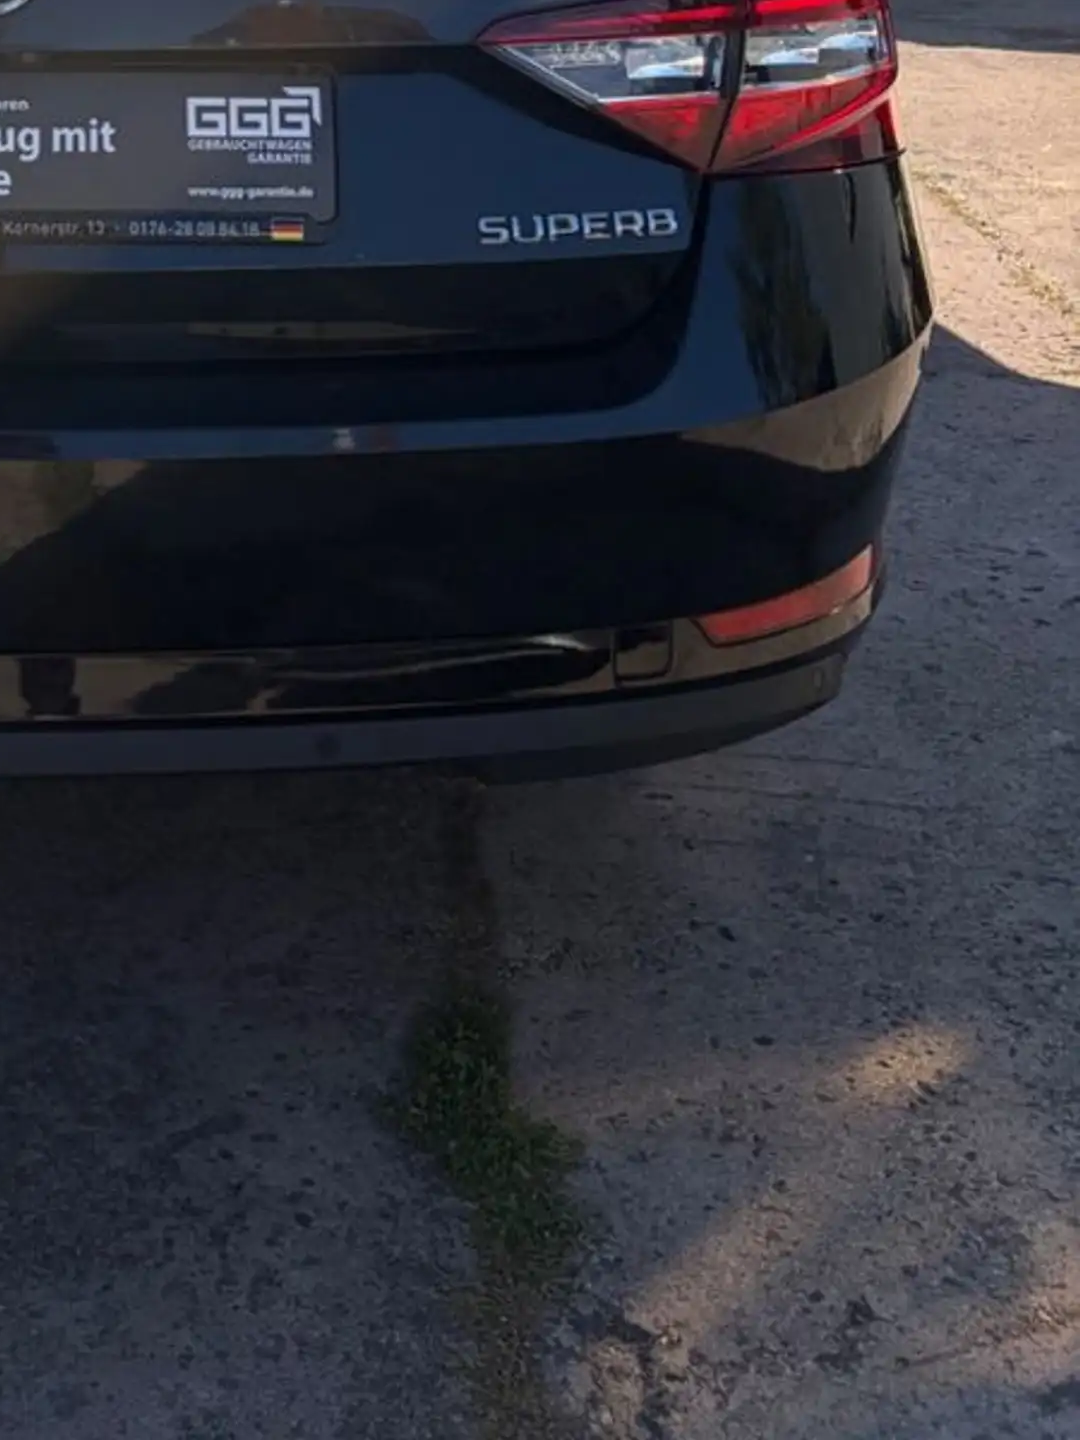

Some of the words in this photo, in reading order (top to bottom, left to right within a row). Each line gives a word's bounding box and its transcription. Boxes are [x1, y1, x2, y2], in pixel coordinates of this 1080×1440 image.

[186, 97, 312, 138] GGG
[52, 118, 117, 153] mit
[186, 139, 313, 151] GEBRAUCHTWAGEN
[247, 153, 313, 165] GARANTIE
[187, 186, 314, 199] www.ggg-garantie.de
[478, 208, 678, 245] SUPERB
